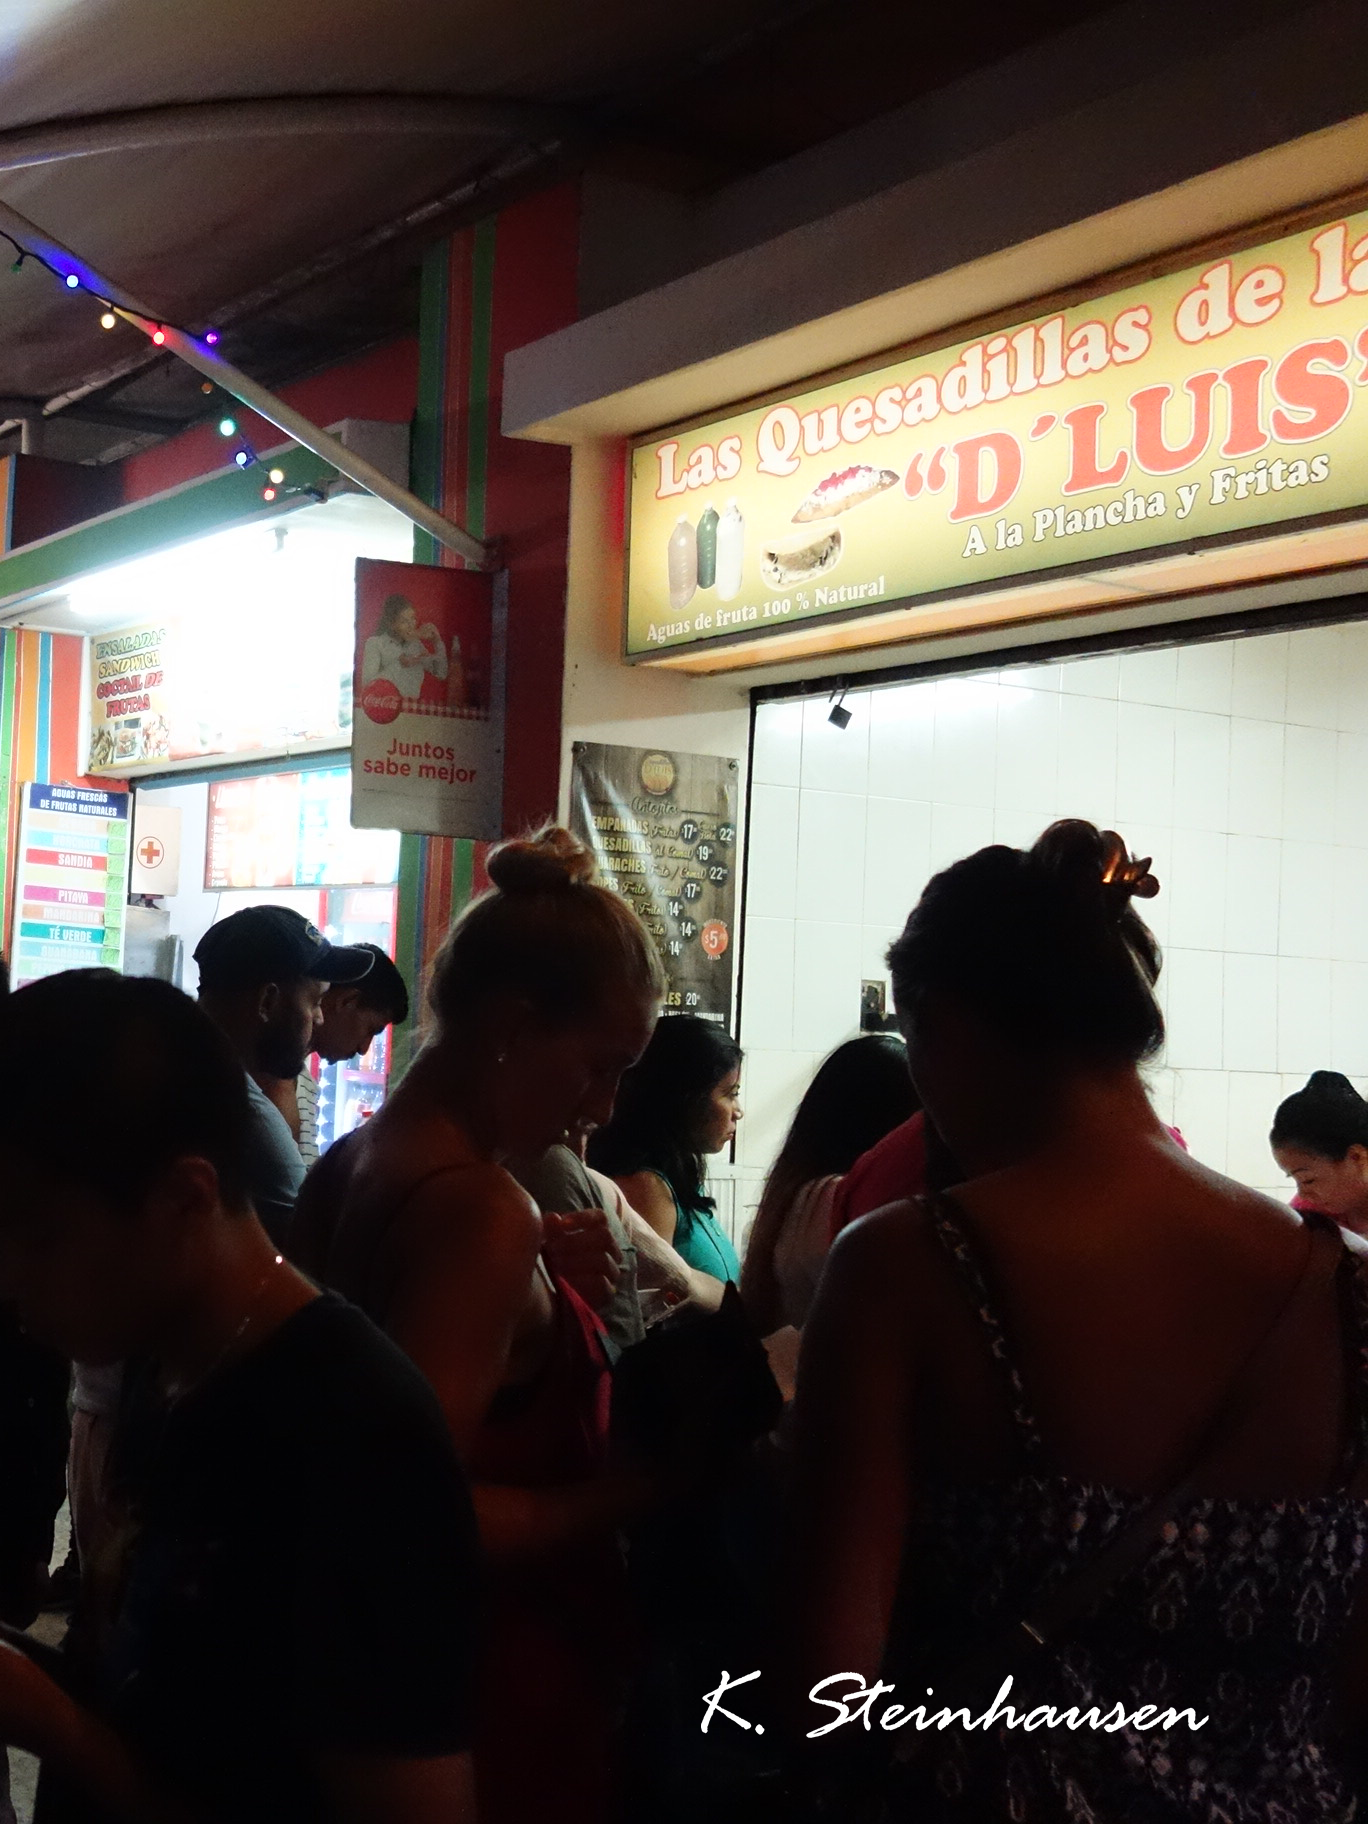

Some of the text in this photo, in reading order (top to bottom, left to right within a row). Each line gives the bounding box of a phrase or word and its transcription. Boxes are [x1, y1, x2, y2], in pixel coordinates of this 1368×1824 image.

[656, 436, 742, 500] Las
[756, 304, 1151, 478] Quesadillas
[1174, 259, 1286, 345] de
[962, 454, 1330, 558] A la Plancha y Fritas
[647, 576, 885, 645] Aguas de fruta 100 % Natural
[96, 628, 167, 659] ENSALADAS
[98, 650, 160, 679] SANDWICH
[97, 671, 164, 699] COCTAIL DE
[106, 694, 151, 718] FRUTAS
[387, 738, 455, 761] Juntos
[363, 758, 477, 785] sabe mejor
[52, 788, 108, 803] AGUAS FRESCAS
[40, 799, 118, 817] DE FRUTAS NATURALES
[593, 816, 649, 834] EMPANADAS
[593, 835, 652, 854] QUESADILLAS
[58, 890, 89, 904] PITAYA
[43, 907, 100, 924] MANDARINA
[49, 926, 92, 942] TÉ VERDE
